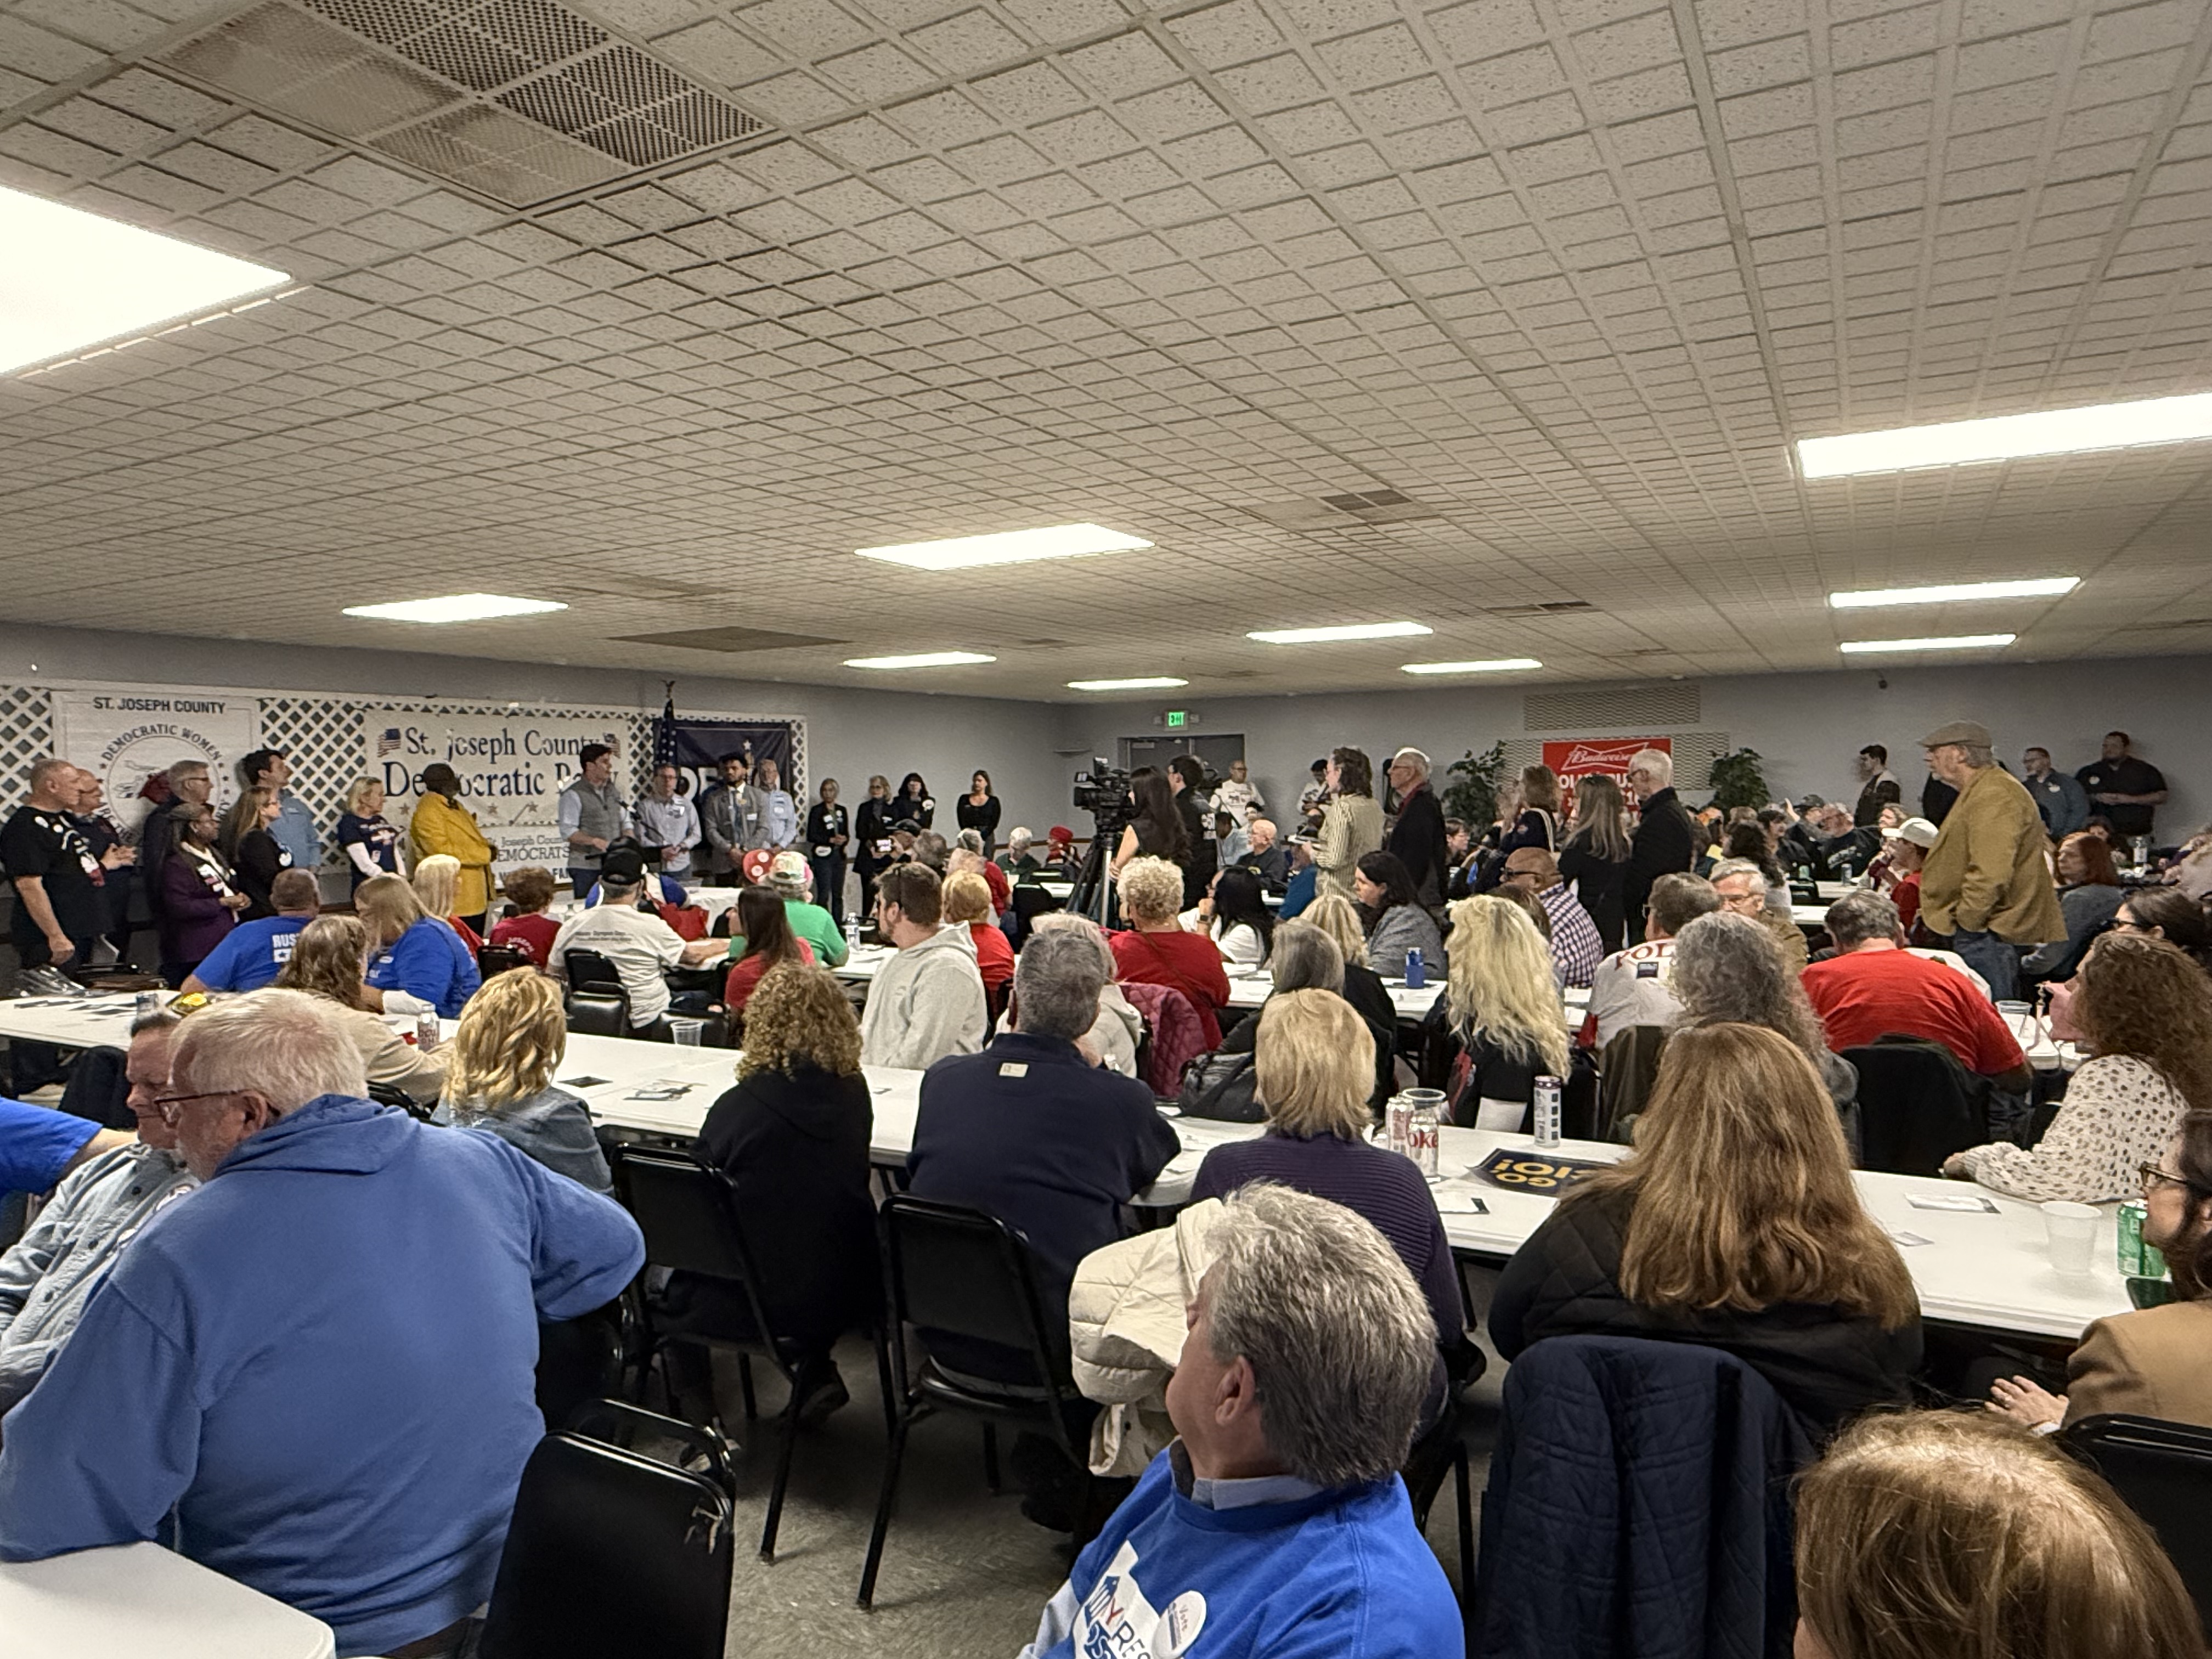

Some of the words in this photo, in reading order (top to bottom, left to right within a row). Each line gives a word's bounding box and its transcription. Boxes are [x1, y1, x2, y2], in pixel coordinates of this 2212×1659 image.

[93, 697, 114, 709] ST.
[117, 698, 171, 712] JOSEPH
[174, 700, 225, 714] COUNTY
[100, 723, 178, 761] DEMOCRATIC
[182, 727, 222, 760] WOMEN
[405, 726, 436, 755] St.
[444, 727, 517, 765] Joseph
[524, 729, 600, 755] Count
[382, 761, 546, 797] Deocratic
[501, 835, 534, 848] Joseph
[537, 834, 562, 844] Coun
[496, 845, 570, 862] EMOCRATS
[272, 933, 301, 949] RUS
[1614, 942, 1674, 971] KOL
[1408, 1130, 1438, 1149] oke
